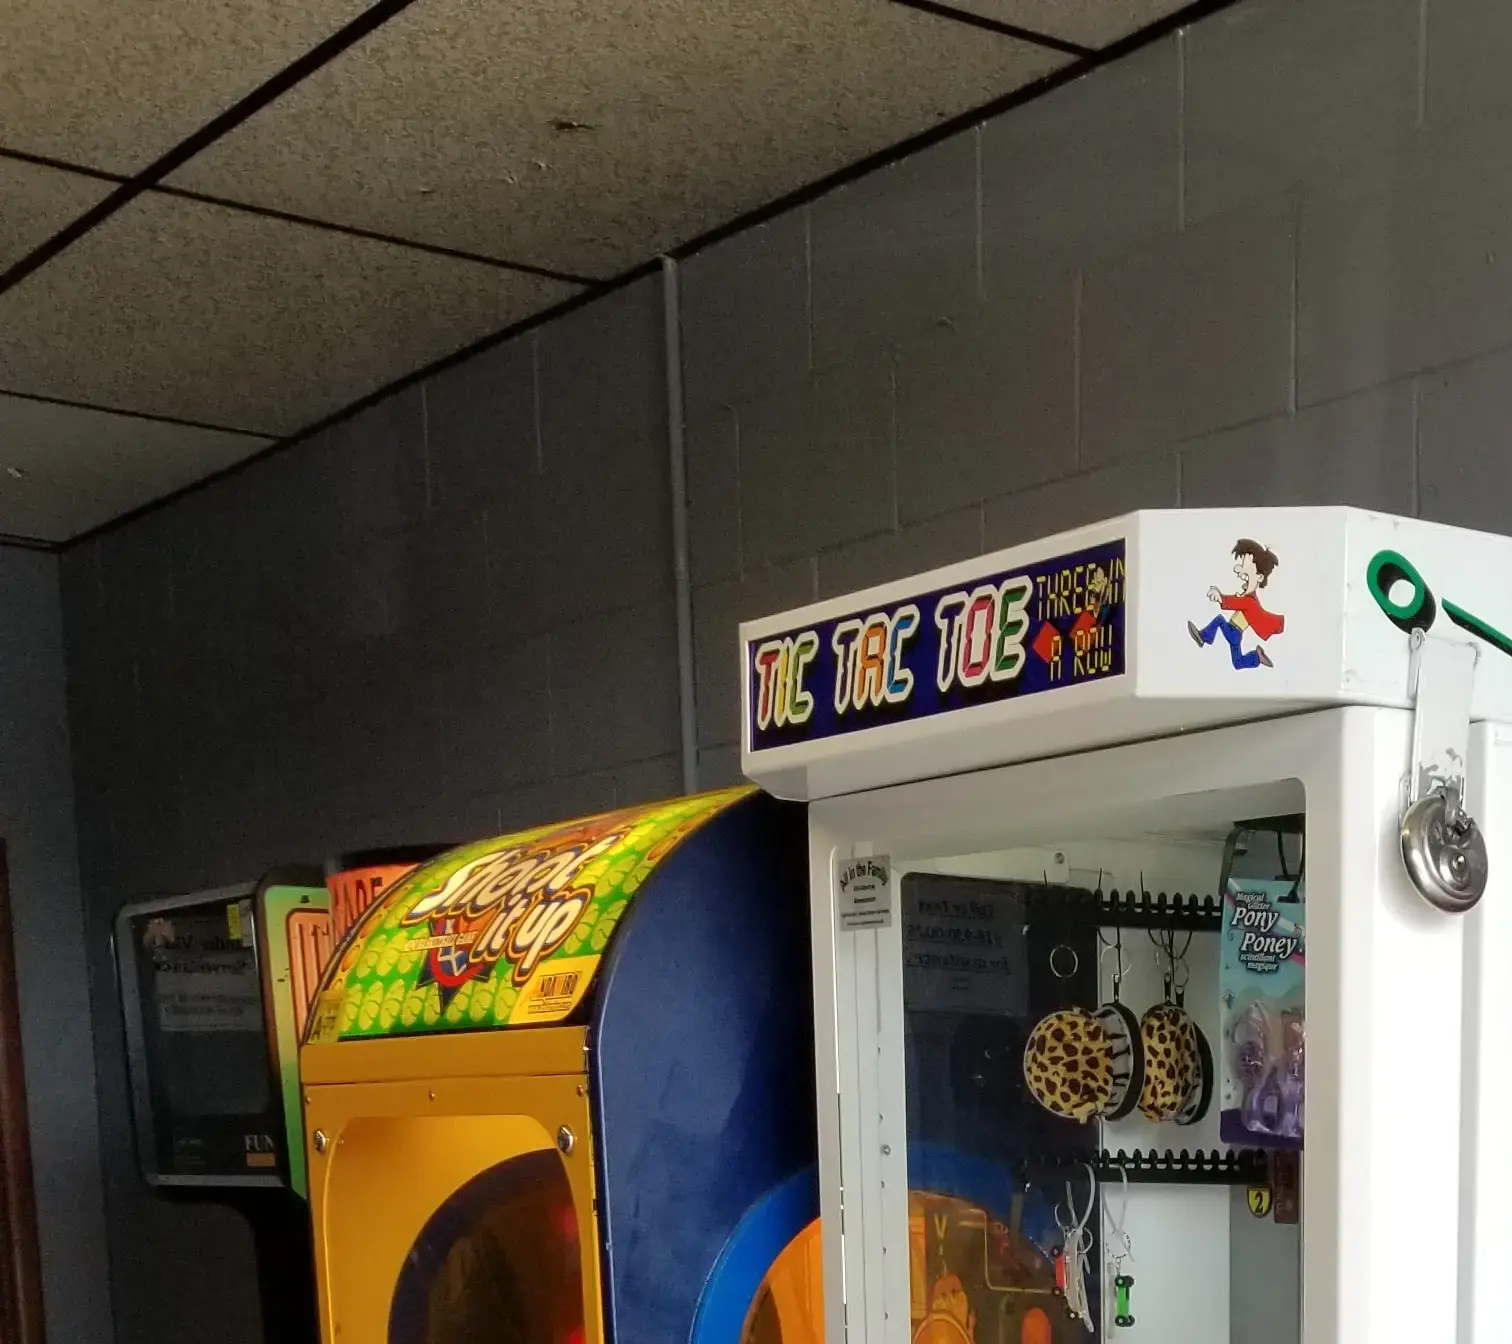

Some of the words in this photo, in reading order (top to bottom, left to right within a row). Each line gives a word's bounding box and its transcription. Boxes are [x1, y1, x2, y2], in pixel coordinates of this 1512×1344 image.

[1036, 562, 1099, 620] THREE
[756, 631, 818, 731] TIC
[832, 604, 920, 715] TAC
[935, 575, 1033, 692] TOE
[1049, 634, 1064, 682] A
[1073, 623, 1114, 677] ROW
[405, 836, 617, 921] Shoot
[512, 896, 586, 973] up
[1231, 907, 1279, 932] Pony
[1241, 932, 1298, 959] Poney
[244, 1134, 274, 1151] FUN
[1255, 1191, 1264, 1214] 2
